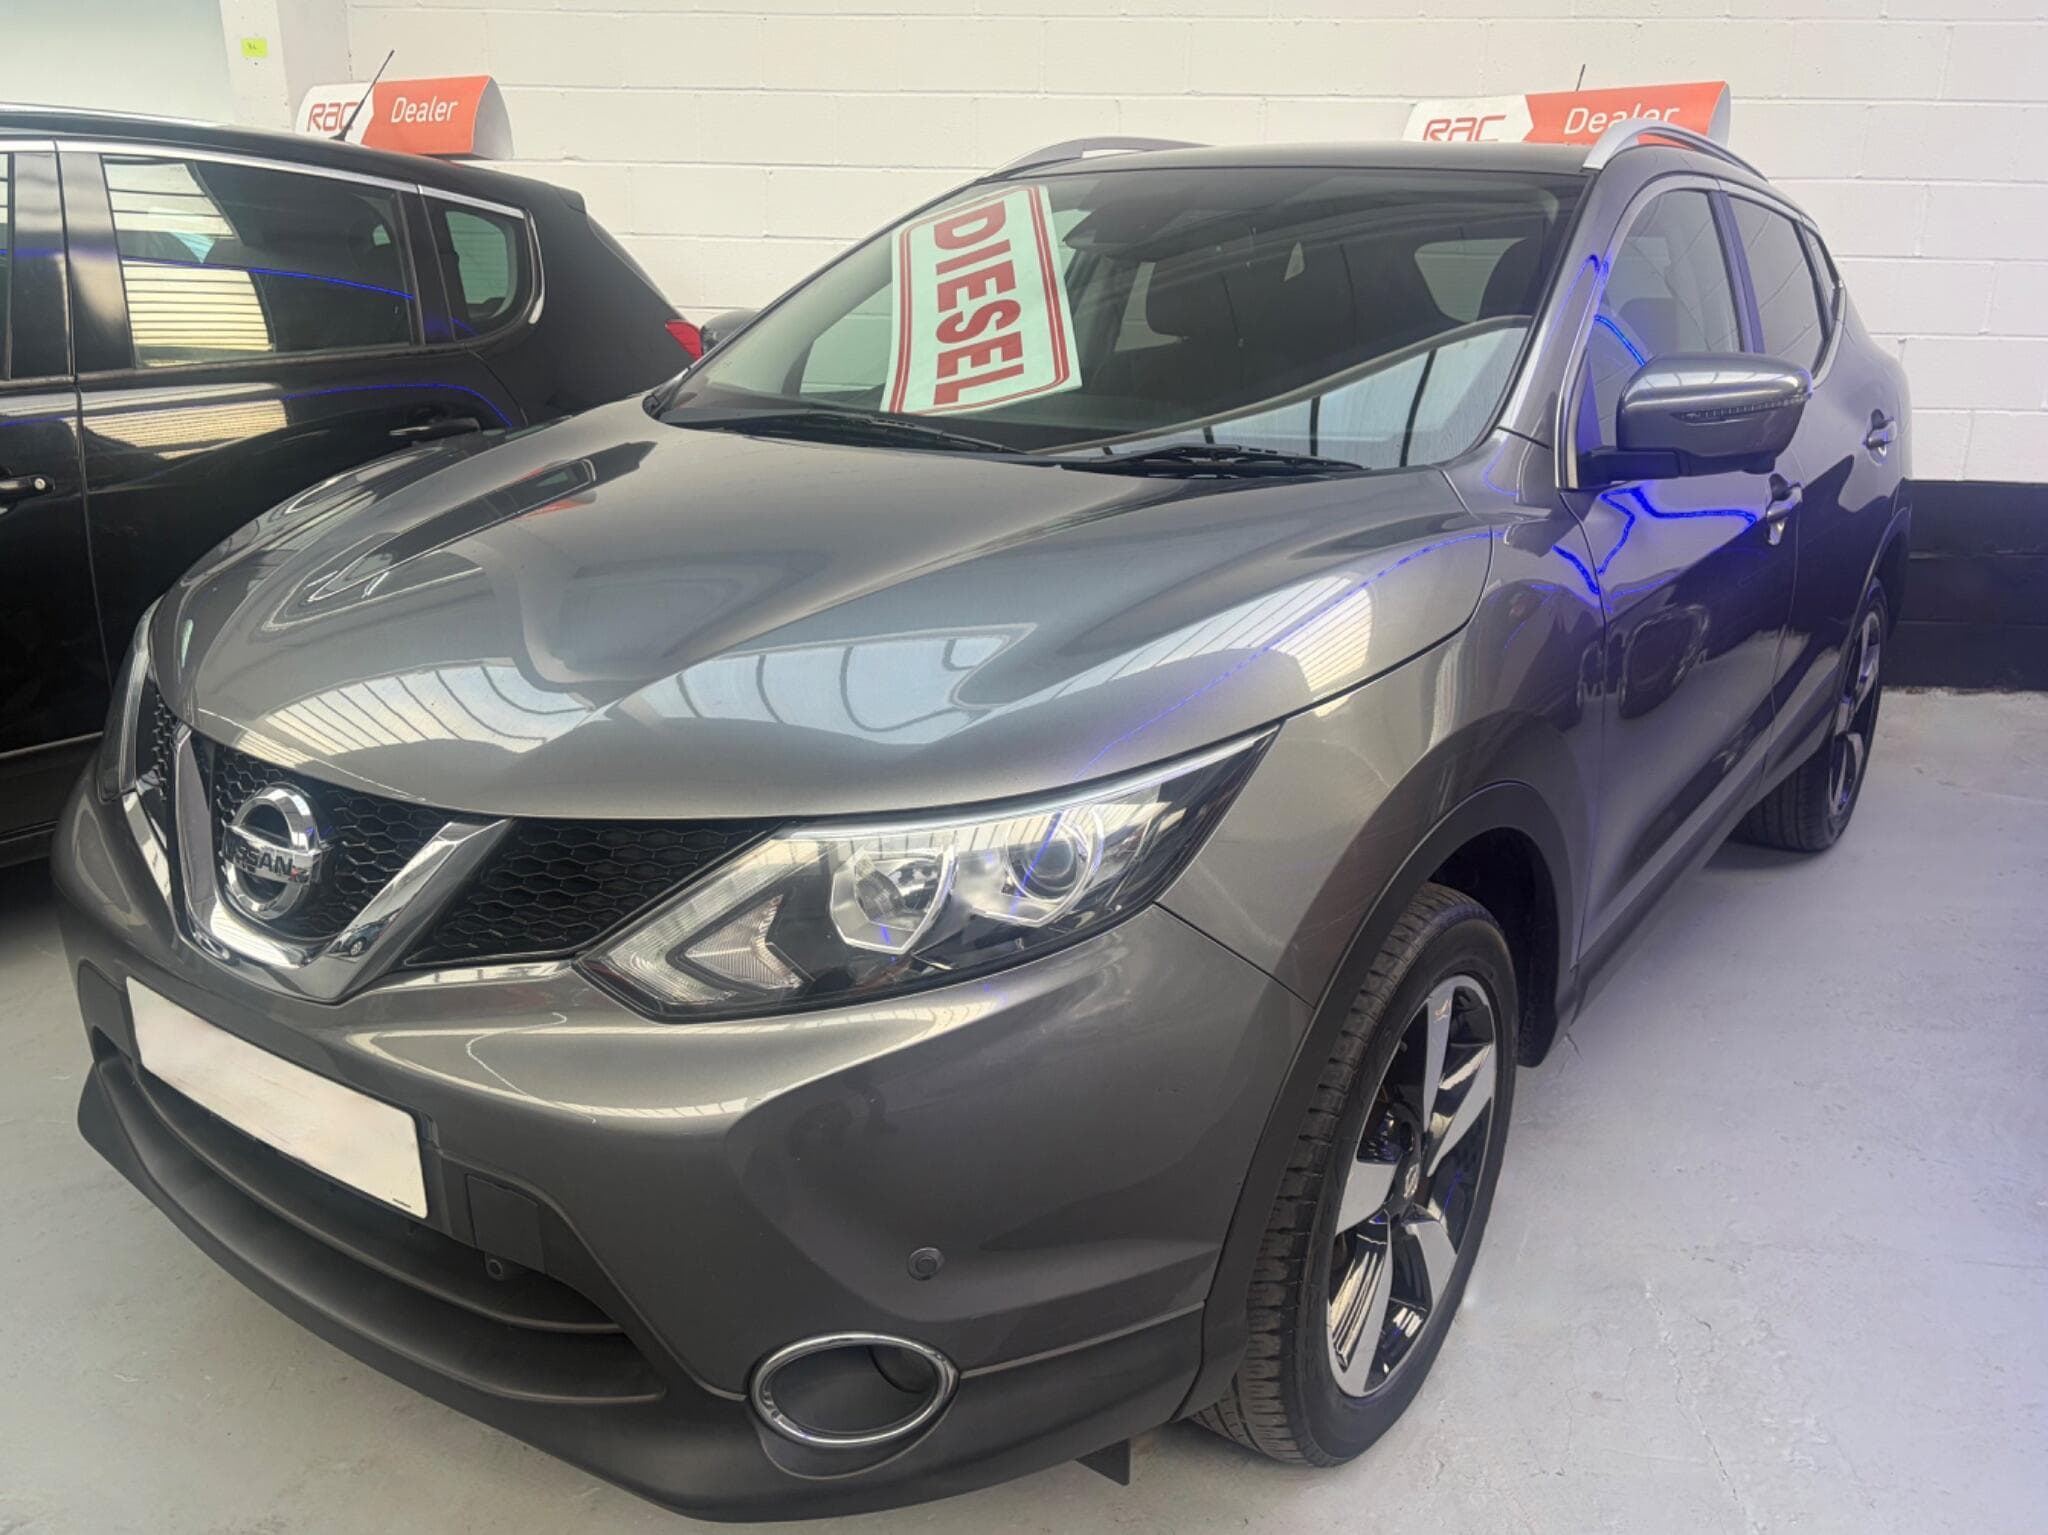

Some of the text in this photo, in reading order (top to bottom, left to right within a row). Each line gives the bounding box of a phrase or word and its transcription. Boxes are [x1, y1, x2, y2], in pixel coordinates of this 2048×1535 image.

[391, 96, 459, 123] Dealer
[1422, 114, 1506, 141] RAC
[933, 200, 1024, 405] DIESEL
[225, 834, 294, 876] SSAN
